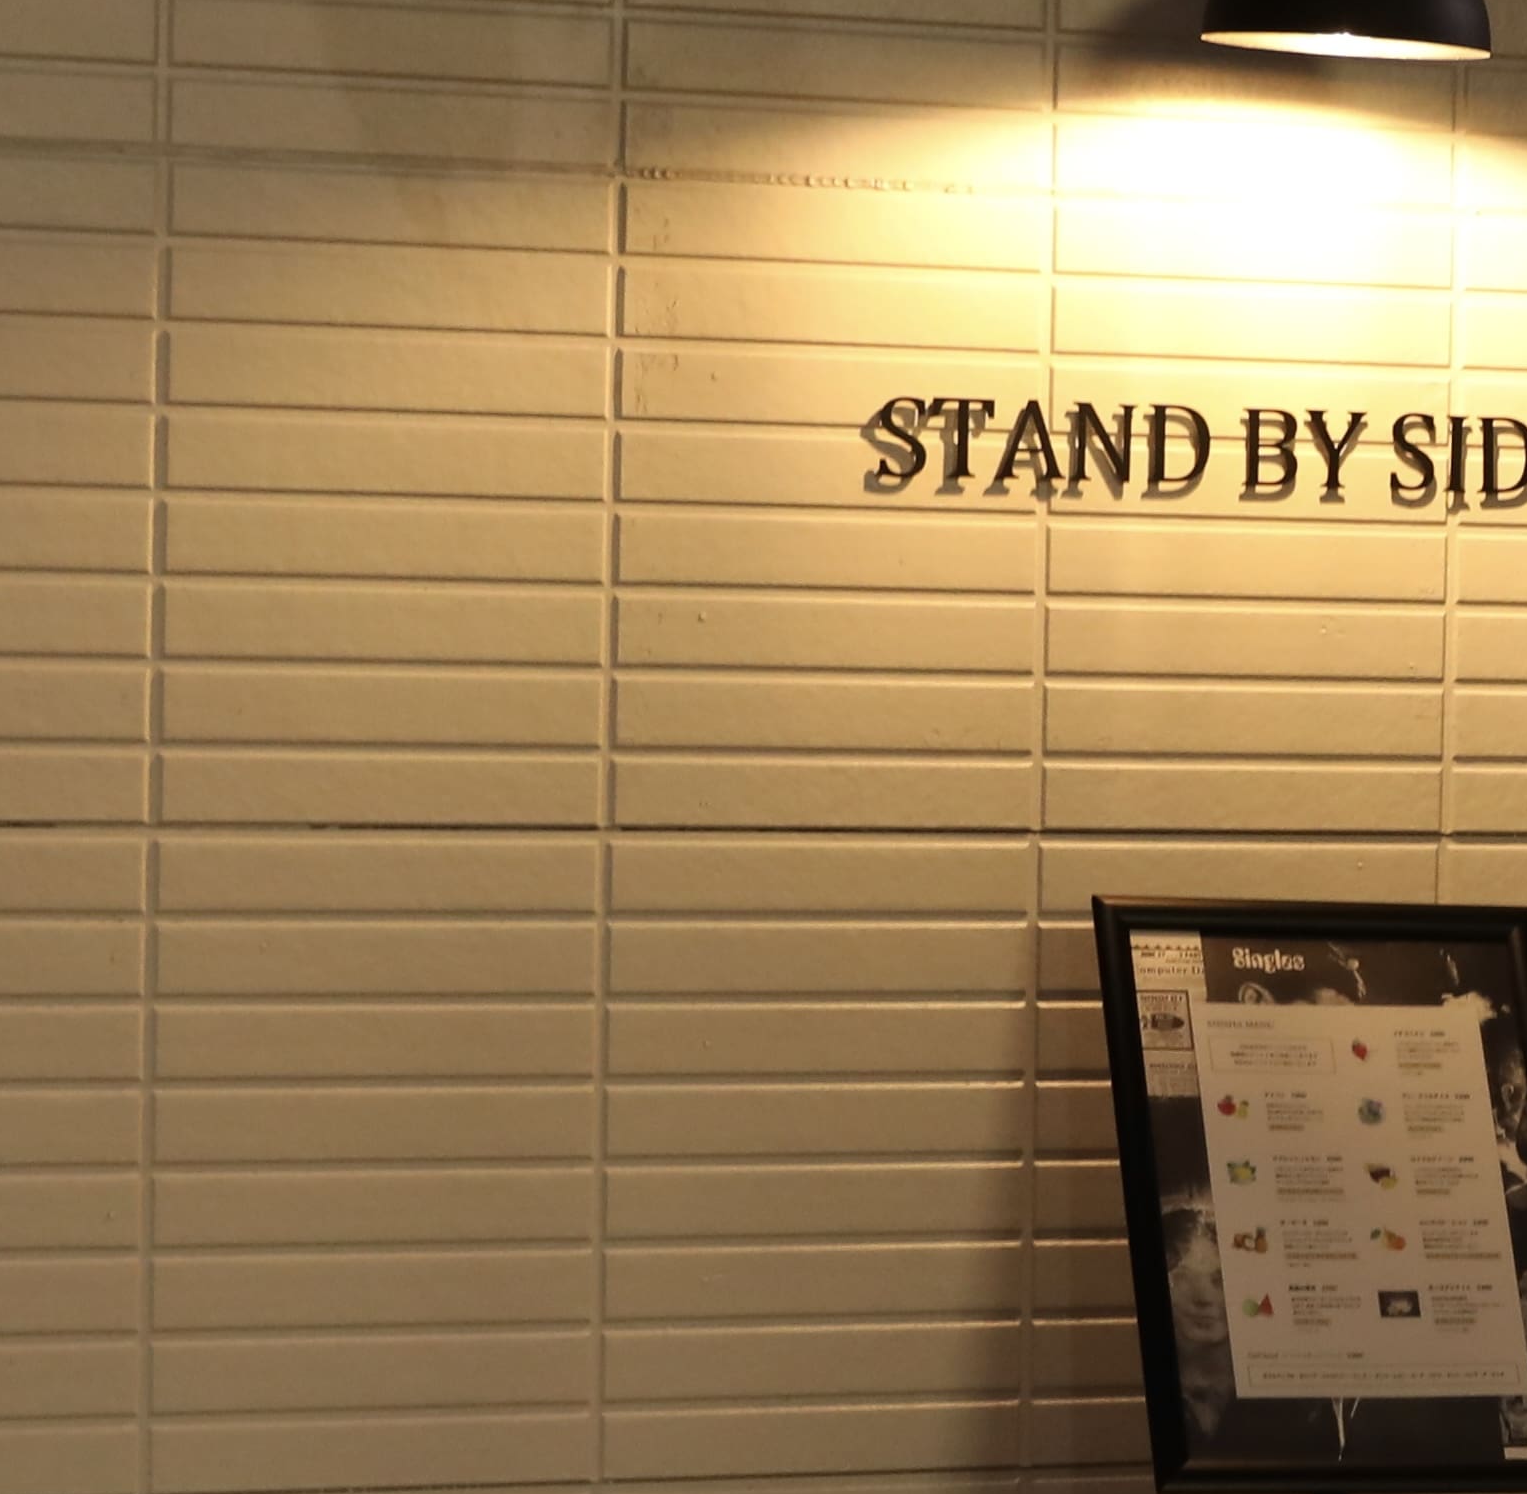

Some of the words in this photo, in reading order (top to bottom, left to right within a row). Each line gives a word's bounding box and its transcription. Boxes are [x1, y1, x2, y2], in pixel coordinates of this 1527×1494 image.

[876, 396, 1212, 484] STAND
[1242, 408, 1367, 490] BY
[1232, 946, 1306, 974] Singles
